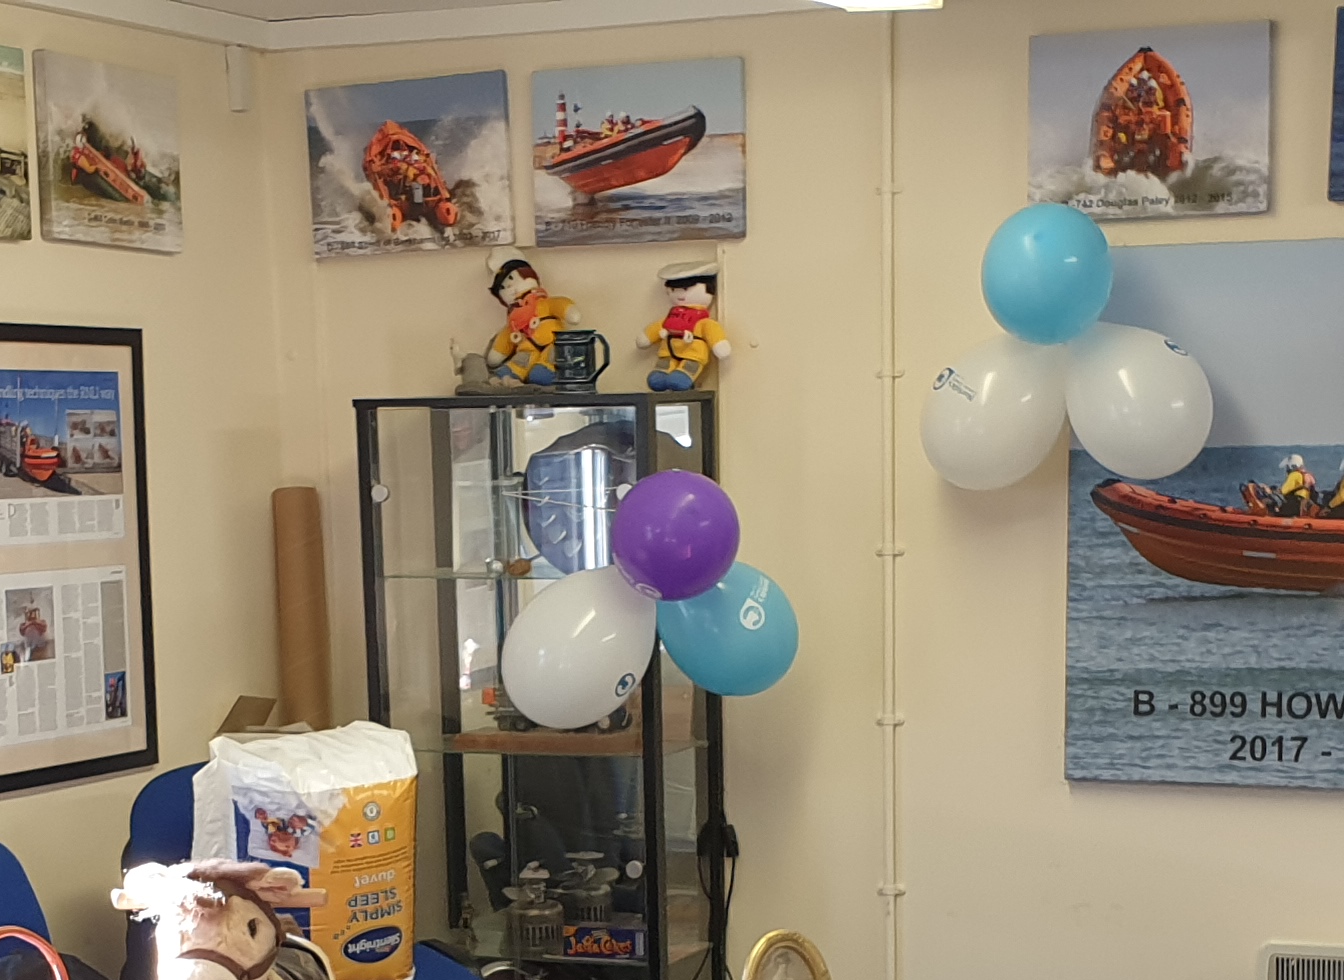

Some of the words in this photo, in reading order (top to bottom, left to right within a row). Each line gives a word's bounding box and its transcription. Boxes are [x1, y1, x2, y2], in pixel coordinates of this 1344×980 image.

[1132, 689, 1156, 717] B
[1188, 690, 1248, 718] 899
[1228, 733, 1308, 763] 2017
[354, 868, 397, 888] duvet
[347, 886, 398, 908] SLEEP
[347, 900, 403, 924] SIMPLY
[347, 930, 401, 955] Silentnight
